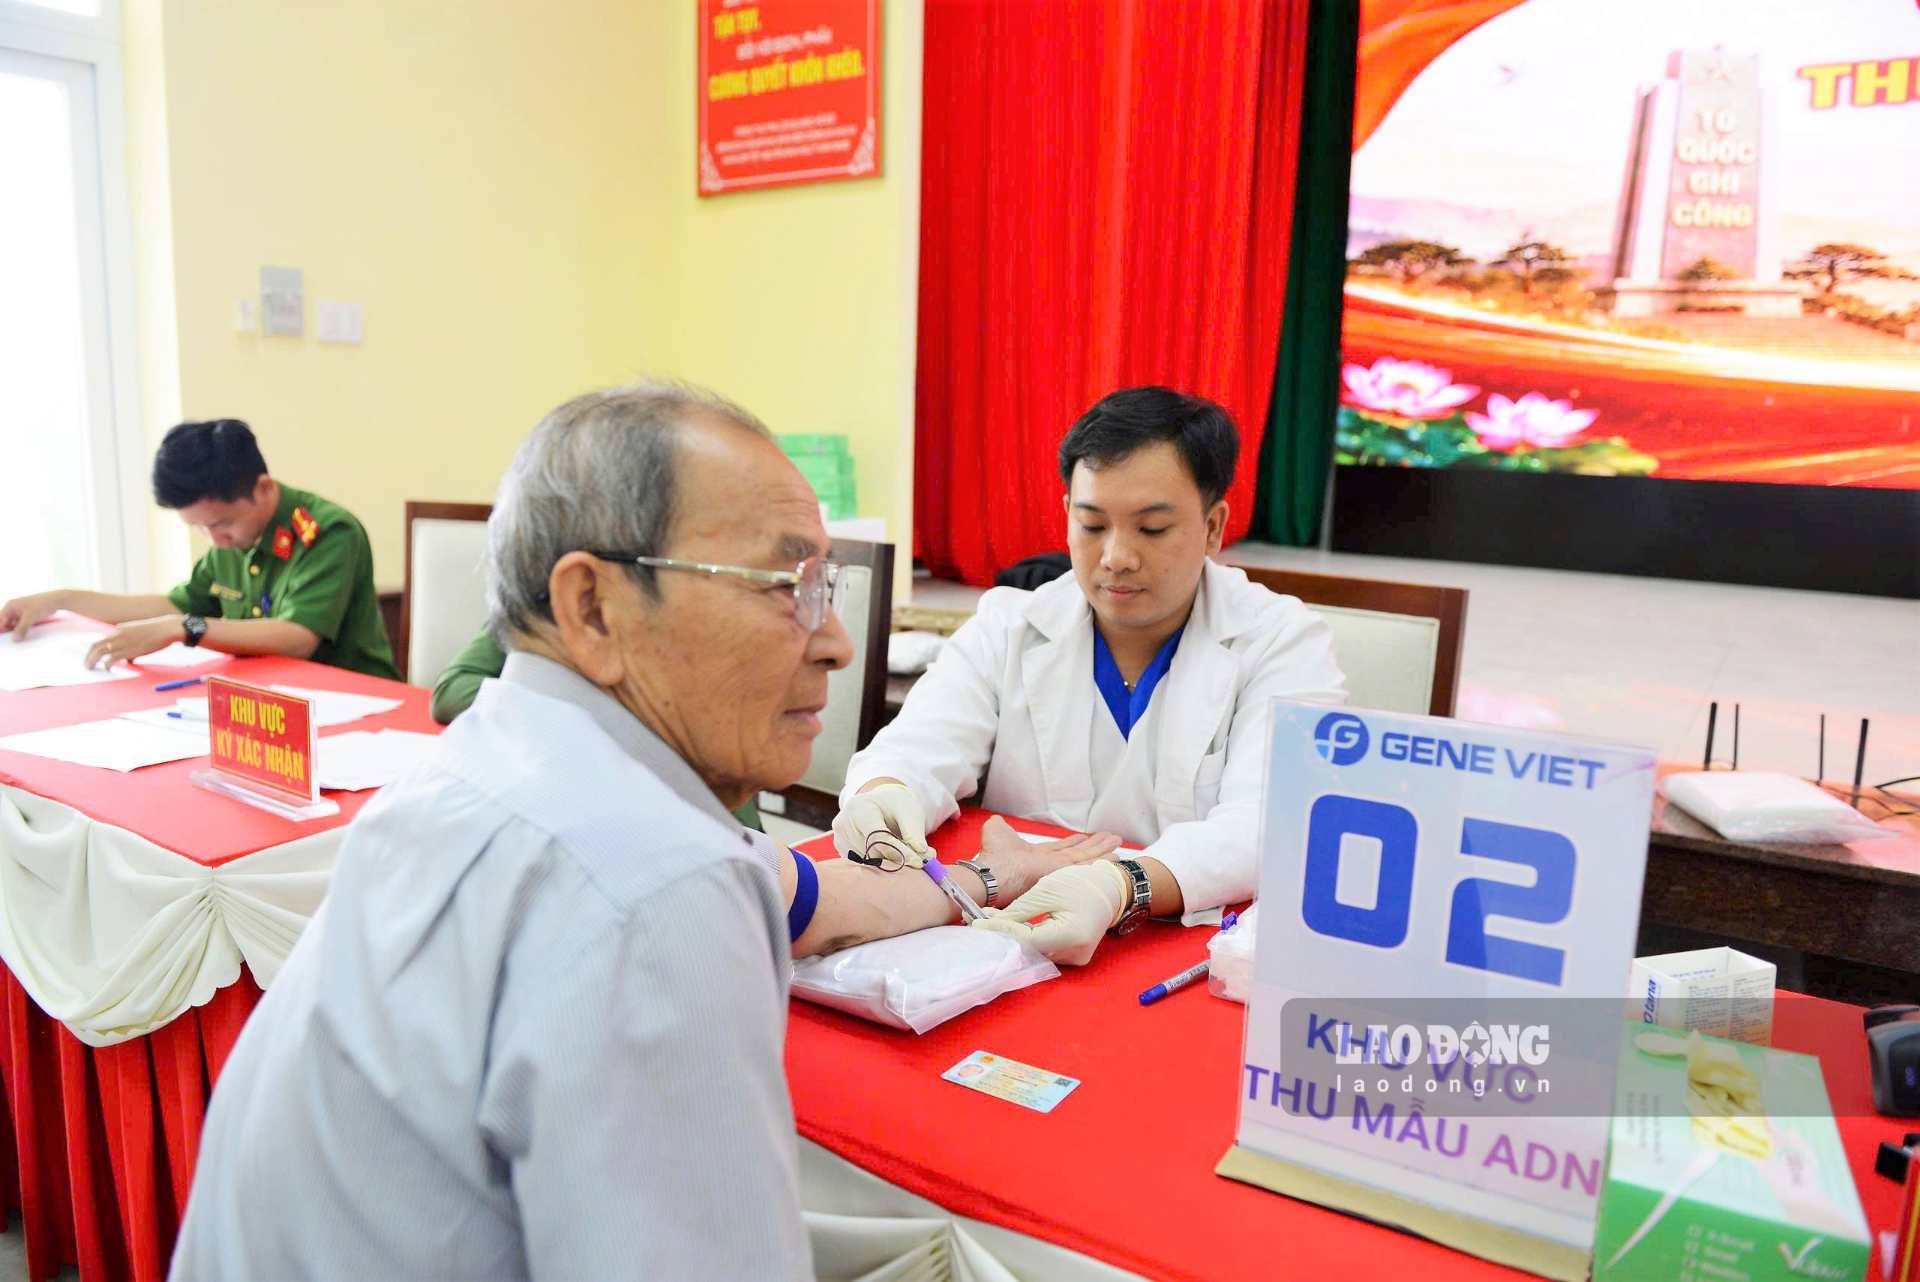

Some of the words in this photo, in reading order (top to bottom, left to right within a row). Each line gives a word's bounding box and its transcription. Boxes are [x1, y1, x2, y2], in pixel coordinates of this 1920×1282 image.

[230, 694, 256, 727] KHU
[258, 703, 286, 738] VỰC
[216, 727, 232, 760] KÝ
[236, 732, 262, 769] XÁC
[264, 744, 305, 785] NHẬN
[1380, 731, 1496, 774] GENE
[1505, 747, 1606, 790] VIET
[1302, 793, 1578, 987] 02
[1306, 1012, 1411, 1071] KHU
[1245, 1064, 1337, 1121] THU
[1352, 1096, 1468, 1159] MẪU
[1482, 1133, 1601, 1197] ADN
